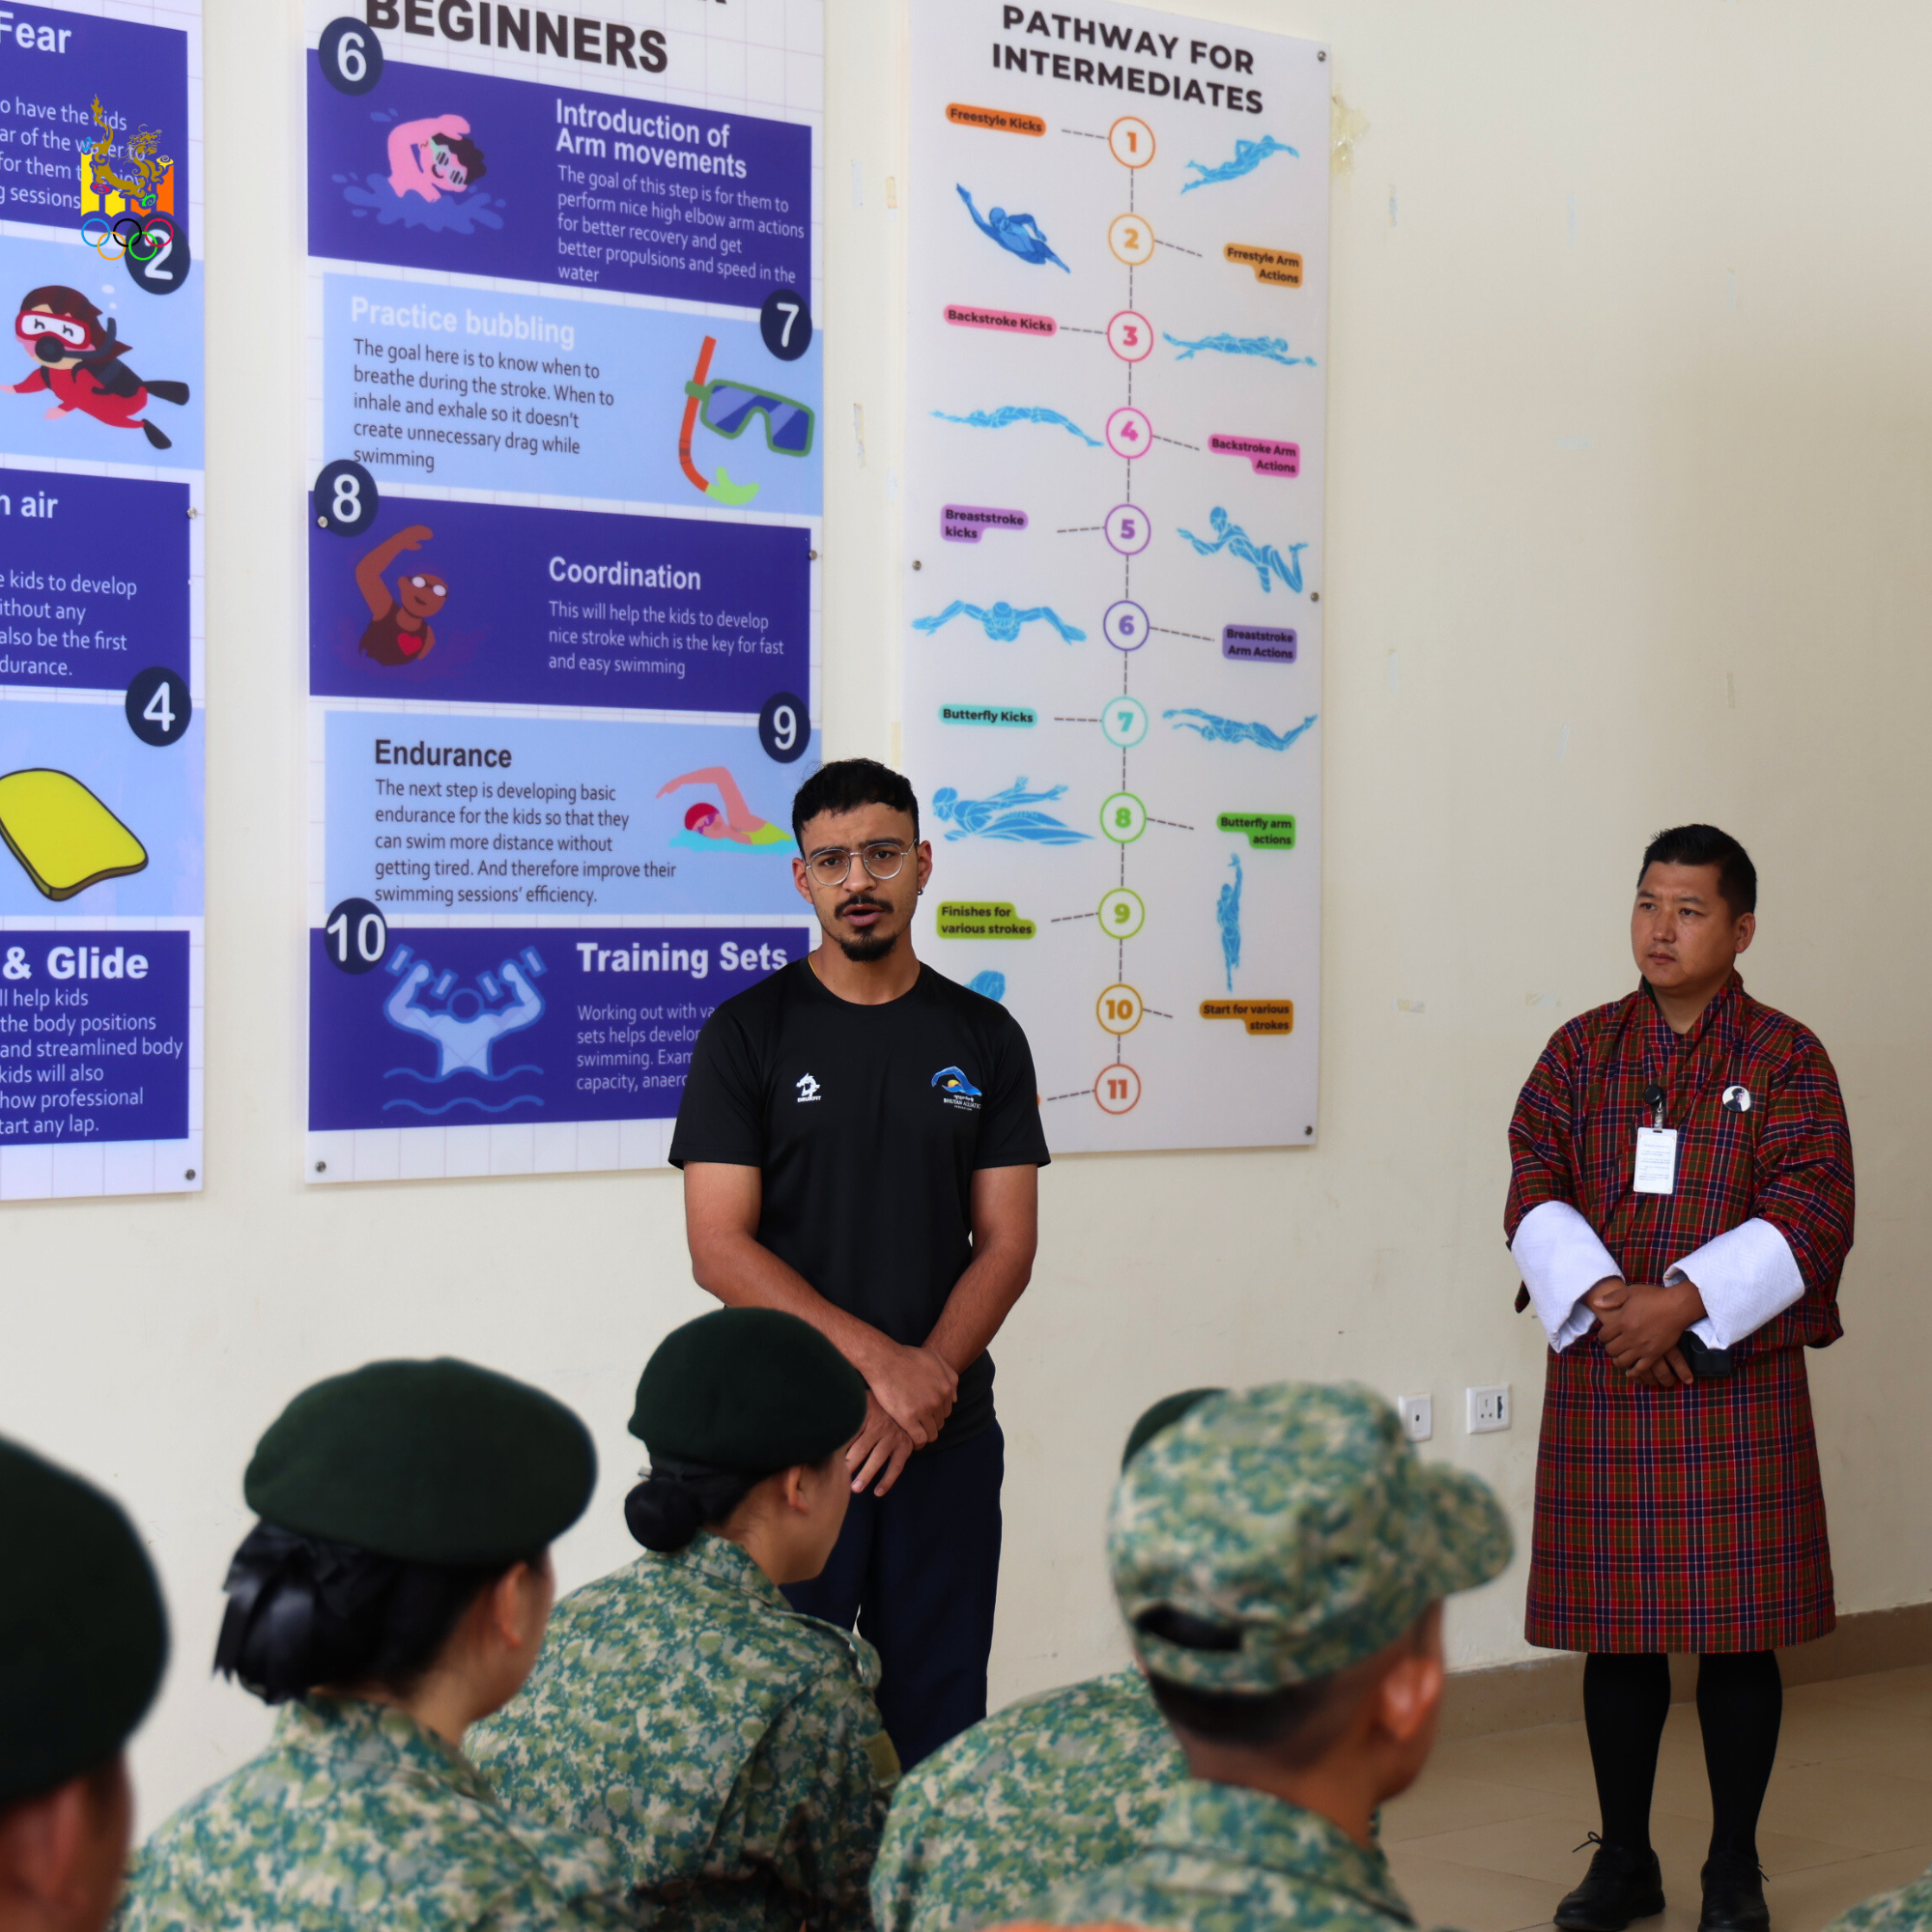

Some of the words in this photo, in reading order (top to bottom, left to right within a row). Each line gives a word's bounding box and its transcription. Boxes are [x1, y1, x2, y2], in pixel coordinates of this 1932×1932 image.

[365, 0, 668, 73] BEGINNERS
[1003, 4, 1179, 59] PATHWAY
[1190, 40, 1254, 74] FOR
[336, 31, 367, 81] 6
[993, 43, 1263, 114] INTERMEDIATES
[14, 96, 57, 121] have
[60, 104, 90, 126] the
[556, 98, 699, 144] Introduction
[707, 124, 730, 148] of
[950, 107, 1007, 127] Freestyle
[1009, 117, 1042, 132] Kicks
[20, 127, 40, 146] of
[42, 129, 71, 152] the
[1125, 130, 1137, 154] 1
[555, 128, 606, 157] Arm
[614, 141, 747, 179] movements
[26, 157, 71, 180] them
[10, 187, 81, 210] sessions
[557, 192, 616, 213] perform
[619, 199, 648, 217] nice
[651, 201, 681, 225] high
[684, 207, 725, 227] elbow
[728, 216, 754, 231] arm
[757, 220, 805, 239] actions
[1123, 228, 1140, 249] 2
[143, 228, 174, 281] 2
[1276, 255, 1299, 267] Arm
[557, 266, 599, 282] water
[1259, 269, 1298, 284] Actions
[351, 296, 457, 332] Practice
[466, 308, 574, 351] bubbling
[776, 302, 800, 347] 7
[948, 309, 1017, 327] Backstroke
[1019, 318, 1053, 331] Kicks
[1122, 325, 1138, 346] 3
[354, 364, 414, 387] breathe
[418, 371, 468, 397] during
[471, 376, 497, 395] the
[500, 381, 550, 400] stroke.
[553, 384, 595, 404] When
[598, 390, 614, 406] to
[354, 393, 401, 412] inhale
[405, 398, 434, 415] and
[438, 400, 487, 420] exhale
[491, 408, 508, 422] so
[512, 406, 522, 423] it
[354, 423, 403, 440] create
[407, 428, 501, 451] unnecessary
[504, 431, 538, 456] drag
[541, 435, 580, 454] while
[1120, 420, 1139, 442] 4
[1211, 438, 1271, 454] Backstroke
[1273, 444, 1296, 457] Arm
[353, 447, 434, 473] swimming
[1256, 459, 1295, 473] Actions
[20, 490, 58, 519] air
[332, 473, 362, 523] 8
[945, 509, 1024, 526] Breaststroke
[1121, 519, 1136, 539] 5
[945, 526, 978, 539] kicks
[10, 569, 44, 590] kids
[47, 574, 67, 591] to
[71, 573, 137, 600] develop
[549, 555, 700, 590] Coordination
[55, 606, 86, 625] any
[1118, 615, 1134, 636] 6
[37, 627, 58, 647] be
[61, 629, 90, 649] the
[94, 630, 127, 651] first
[1226, 628, 1293, 642] Breaststroke
[1228, 644, 1252, 656] Arm
[1253, 646, 1293, 659] Actions
[548, 652, 575, 669] and
[579, 657, 611, 675] easy
[613, 656, 685, 679] swimming
[143, 681, 176, 732] 4
[943, 708, 998, 724] Butterfly
[1000, 711, 1033, 723] Kicks
[773, 704, 797, 751] 9
[1117, 711, 1134, 732] 7
[375, 739, 512, 768] Endurance
[375, 778, 405, 796] The
[409, 781, 442, 797] next
[445, 782, 478, 802] step
[482, 781, 494, 798] is
[497, 781, 577, 806] developing
[581, 782, 616, 801] basic
[375, 805, 456, 823] endurance
[459, 806, 481, 824] for
[484, 807, 509, 825] the
[512, 807, 542, 825] kids
[545, 812, 561, 826] so
[564, 809, 594, 826] that
[597, 809, 630, 831] they
[1115, 807, 1131, 829] 8
[1220, 816, 1268, 831] Butterfly
[1269, 820, 1292, 829] arm
[375, 836, 402, 848] can
[406, 833, 445, 849] swim
[449, 837, 489, 850] more
[493, 833, 554, 851] distance
[557, 834, 612, 852] without
[1253, 834, 1292, 845] actions
[375, 859, 431, 881] getting
[434, 858, 473, 876] tired.
[477, 859, 507, 876] And
[510, 859, 580, 877] therefore
[582, 861, 640, 882] improve
[642, 860, 676, 878] their
[375, 885, 454, 907] swimming
[526, 884, 597, 907] efficiency.
[941, 905, 991, 917] Finishes
[993, 906, 1011, 917] for
[1114, 902, 1130, 924] 9
[326, 913, 386, 963] 10
[941, 923, 985, 934] various
[988, 923, 1032, 934] strokes
[2, 946, 32, 980] &
[46, 946, 148, 980] Glide
[576, 942, 708, 979] Training
[720, 941, 787, 971] Sets
[13, 988, 50, 1011] help
[54, 987, 89, 1007] kids
[1104, 999, 1133, 1020] 10
[1203, 1004, 1231, 1014] Start
[1232, 1004, 1248, 1014] for
[1250, 1003, 1290, 1014] various
[33, 1012, 76, 1037] body
[80, 1013, 156, 1036] positions
[1249, 1019, 1289, 1030] strokes
[36, 1037, 137, 1058] streamlined
[142, 1036, 184, 1059] body
[36, 1063, 65, 1082] will
[70, 1063, 103, 1082] also
[41, 1086, 143, 1113] professional
[1106, 1079, 1128, 1099] 11
[33, 1120, 65, 1138] any
[69, 1113, 99, 1136] lap.
